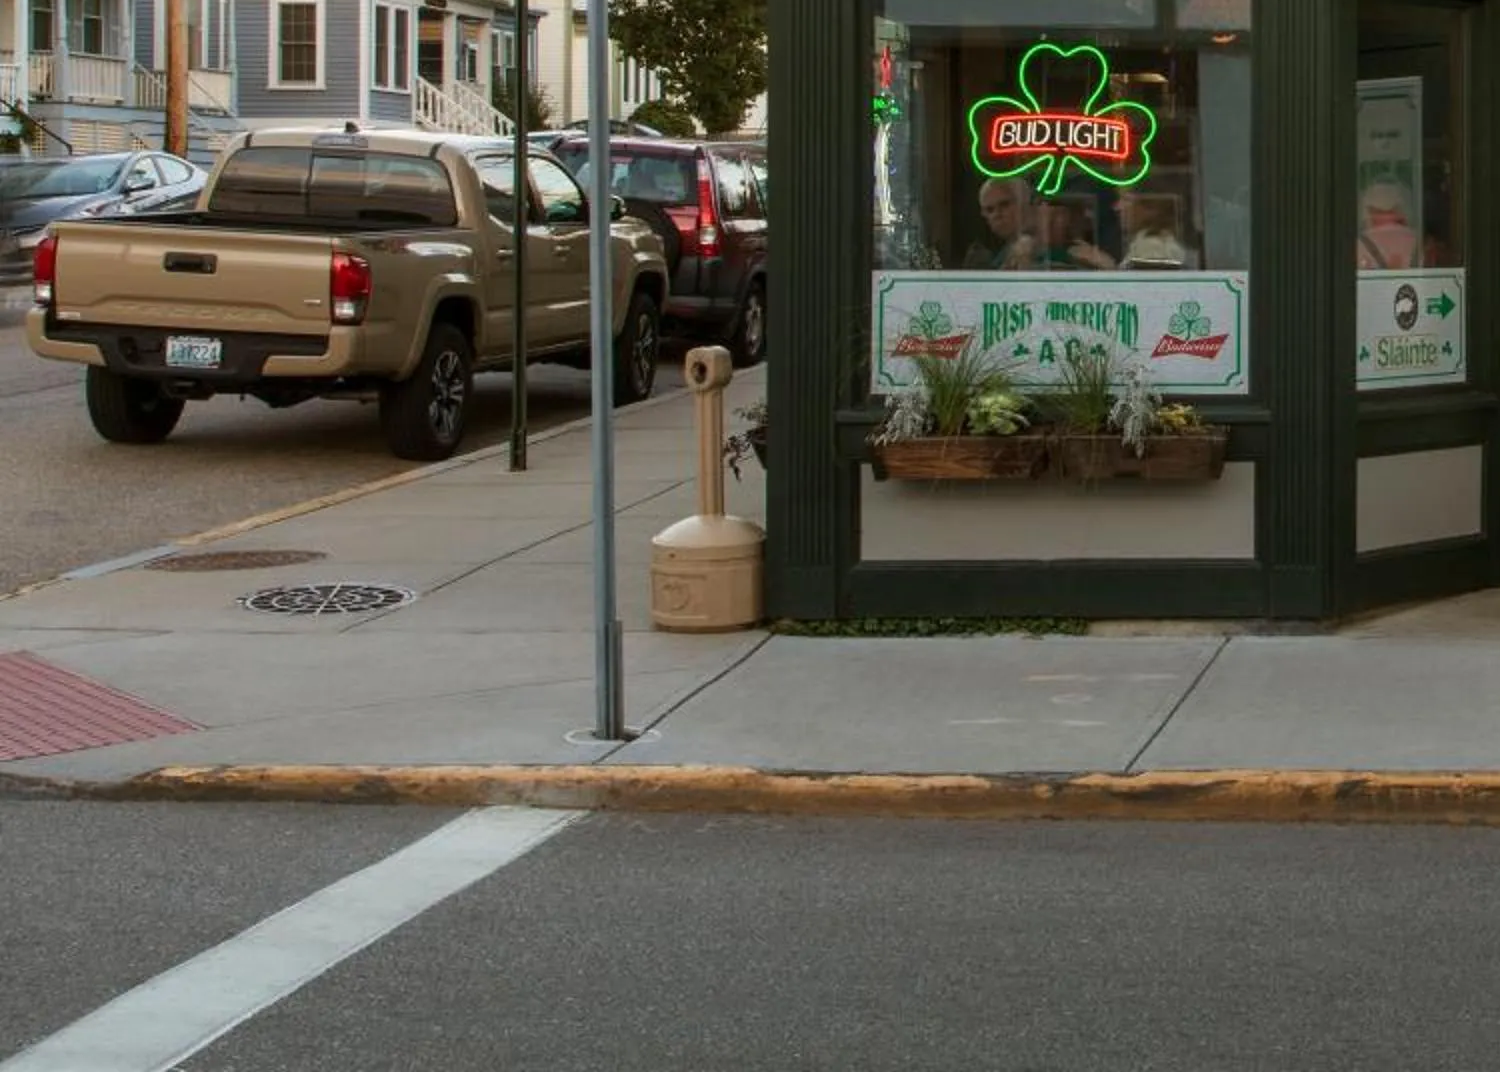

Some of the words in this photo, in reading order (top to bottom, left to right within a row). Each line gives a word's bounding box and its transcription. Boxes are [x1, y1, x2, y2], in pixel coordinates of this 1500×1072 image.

[999, 120, 1051, 147] BUD
[1055, 120, 1124, 151] LIGHT
[983, 301, 1032, 350] IRISH
[1045, 301, 1139, 350] AMERICAN
[1158, 337, 1220, 353] Budweiser
